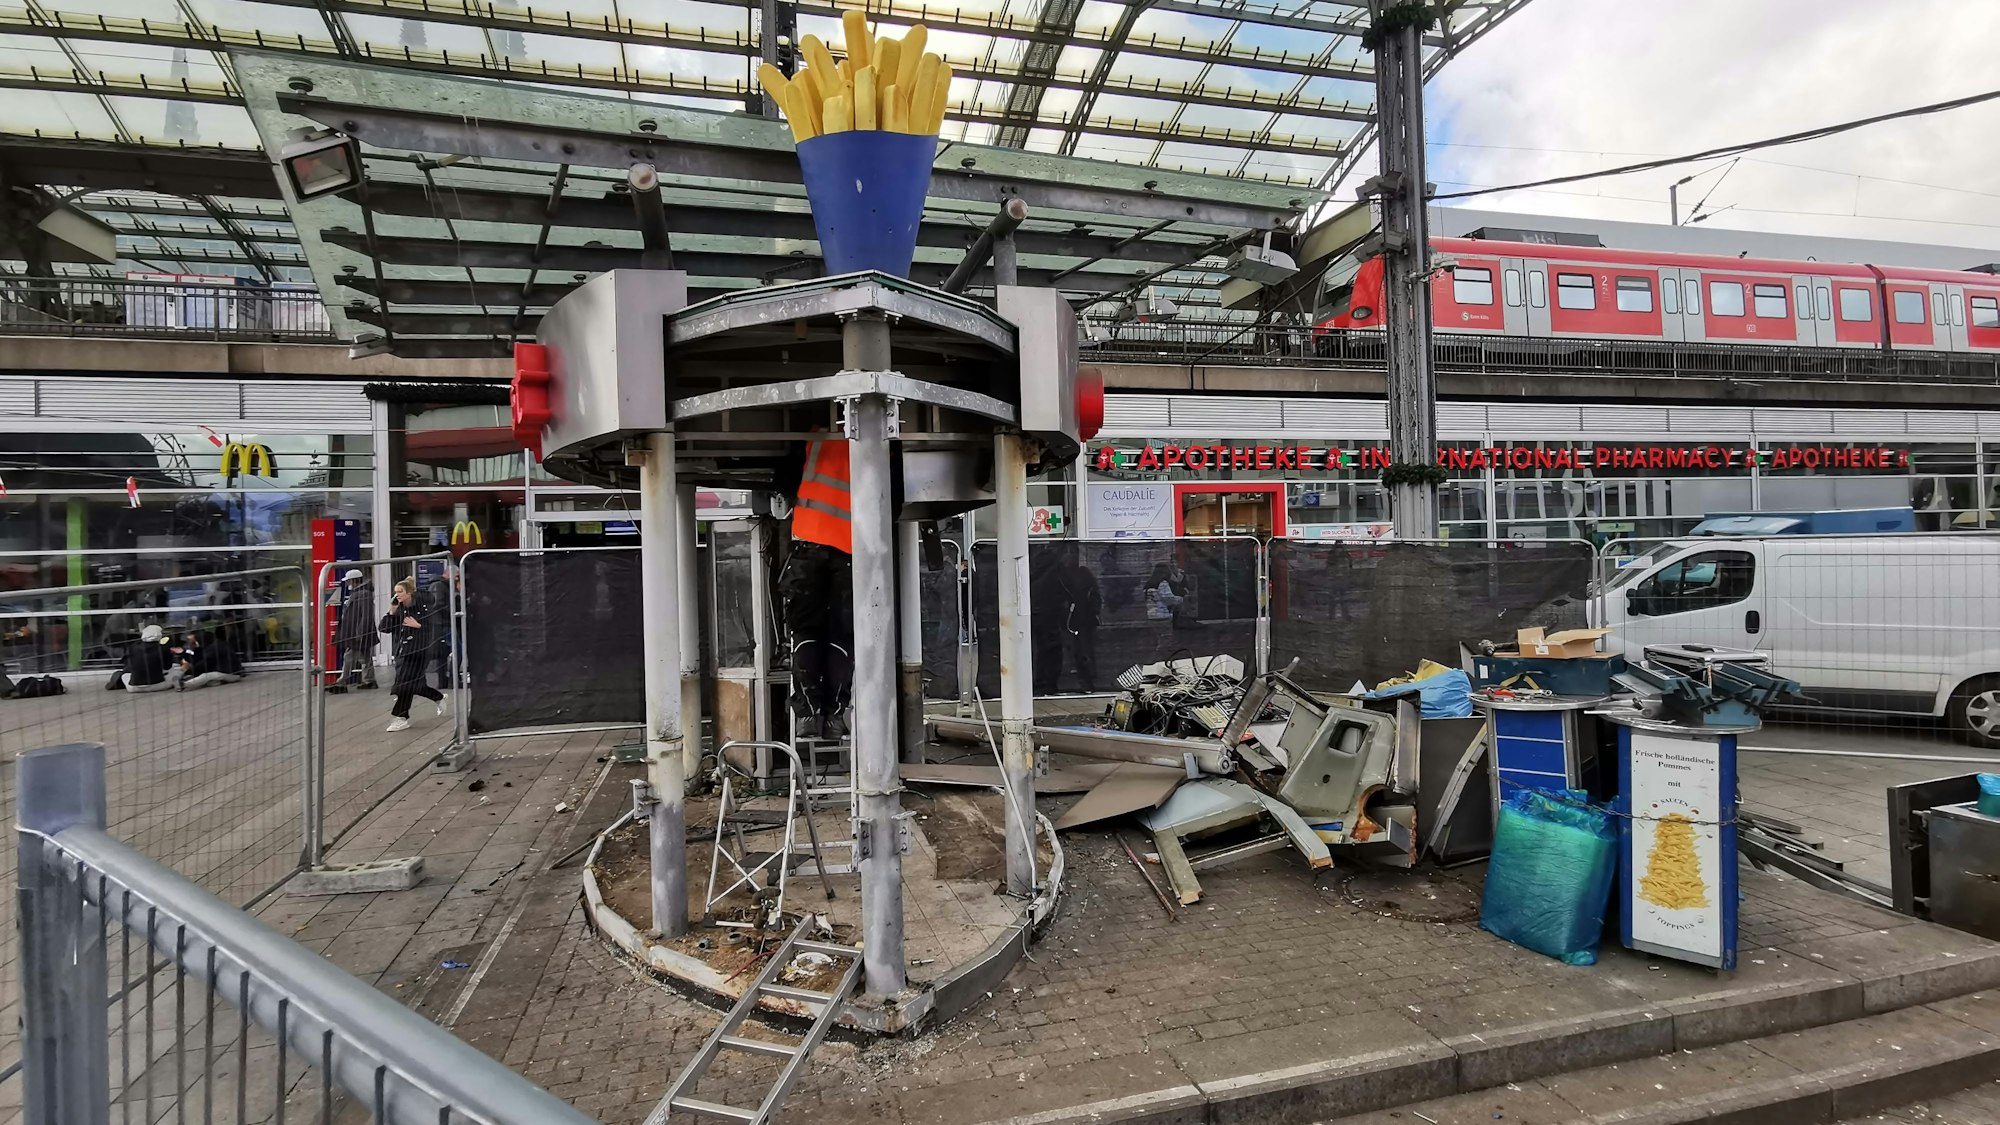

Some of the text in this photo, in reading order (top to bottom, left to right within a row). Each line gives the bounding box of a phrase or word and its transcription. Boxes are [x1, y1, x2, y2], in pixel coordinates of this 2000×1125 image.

[1601, 275, 1608, 286] 2
[1745, 283, 1751, 294] 2
[1137, 446, 1890, 470] APOTHEKE INNATIONAL PHARMACY APOTHEKE
[1635, 749, 1716, 765] Frische holländische
[1658, 761, 1692, 771] Pommes
[1667, 780, 1681, 788] mit
[1660, 798, 1689, 807] SAUCEN
[1657, 916, 1695, 930] TOPPINGS
